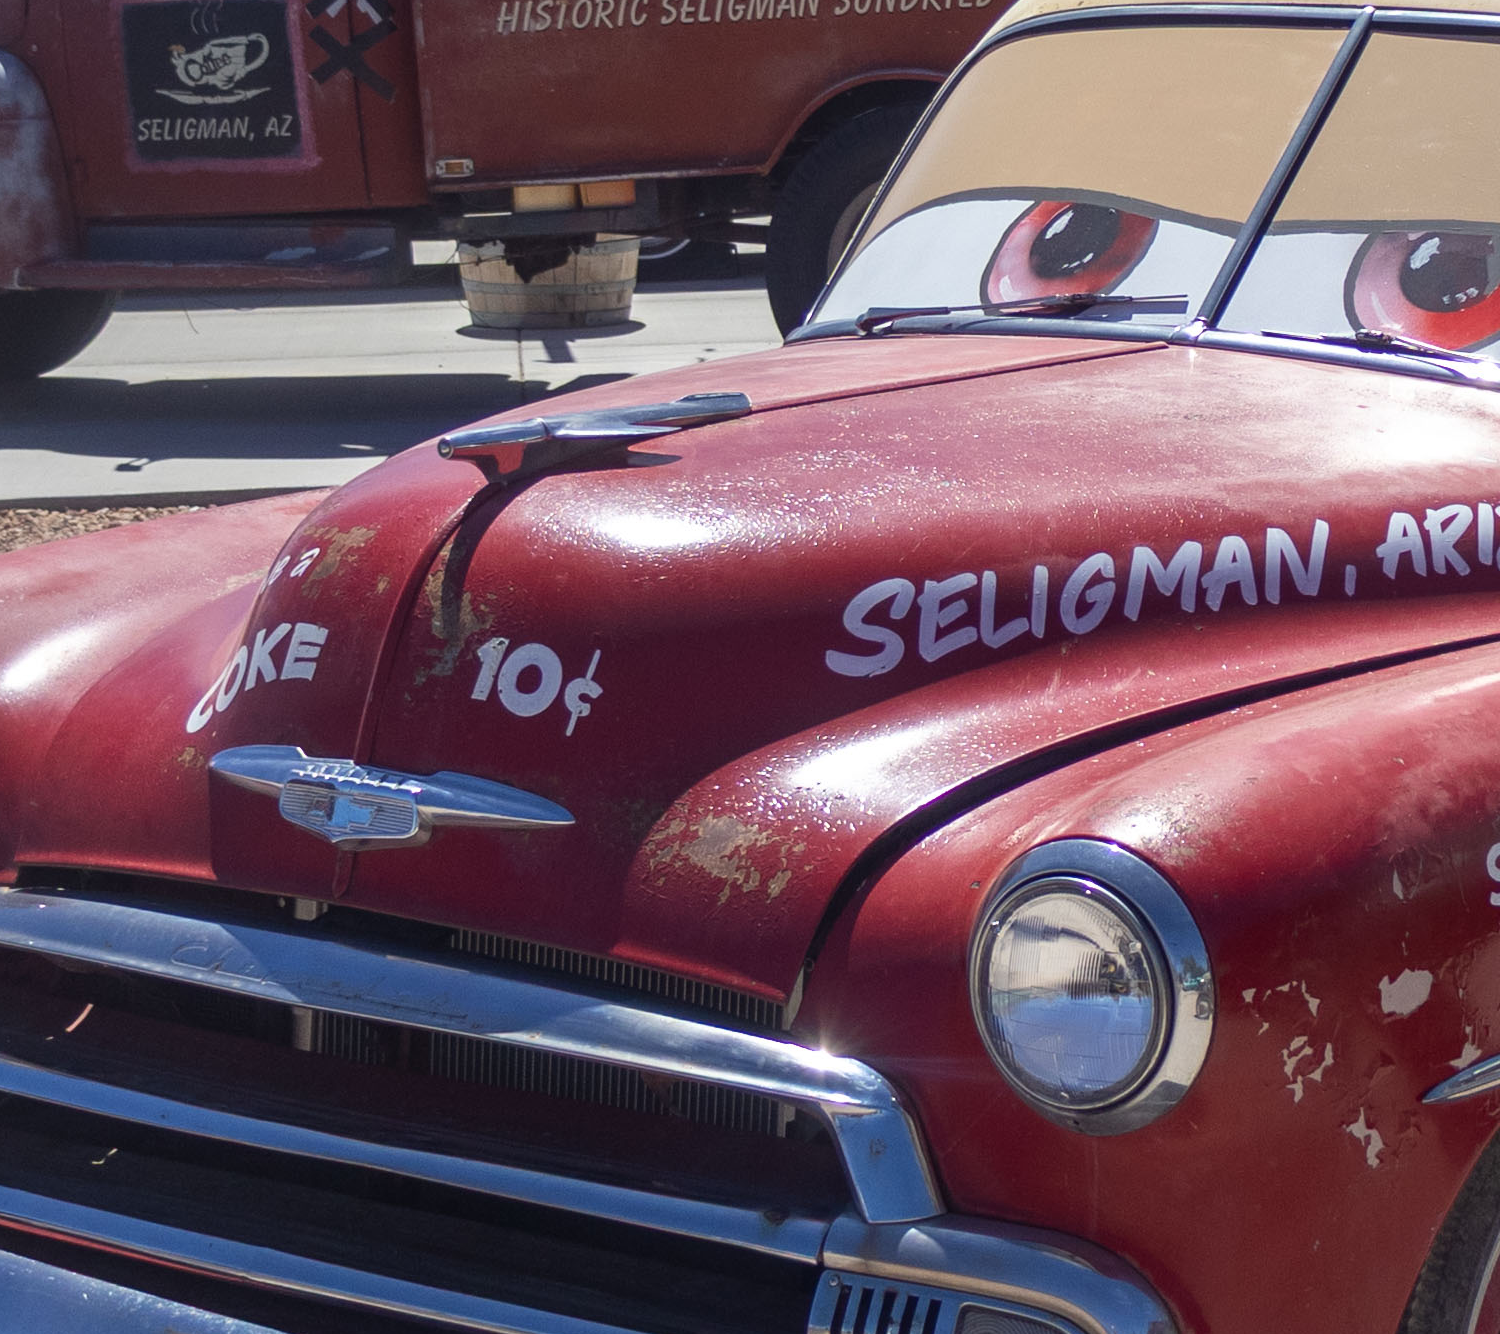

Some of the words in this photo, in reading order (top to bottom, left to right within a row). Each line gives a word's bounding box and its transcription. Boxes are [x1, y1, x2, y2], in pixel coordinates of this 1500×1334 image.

[185, 51, 232, 83] Coffee
[138, 116, 255, 142] SELIGMAN,
[264, 114, 293, 138] AZ
[825, 519, 1358, 678] SELIGMAN,
[186, 621, 329, 734] COKE
[470, 636, 604, 737] 10¢
